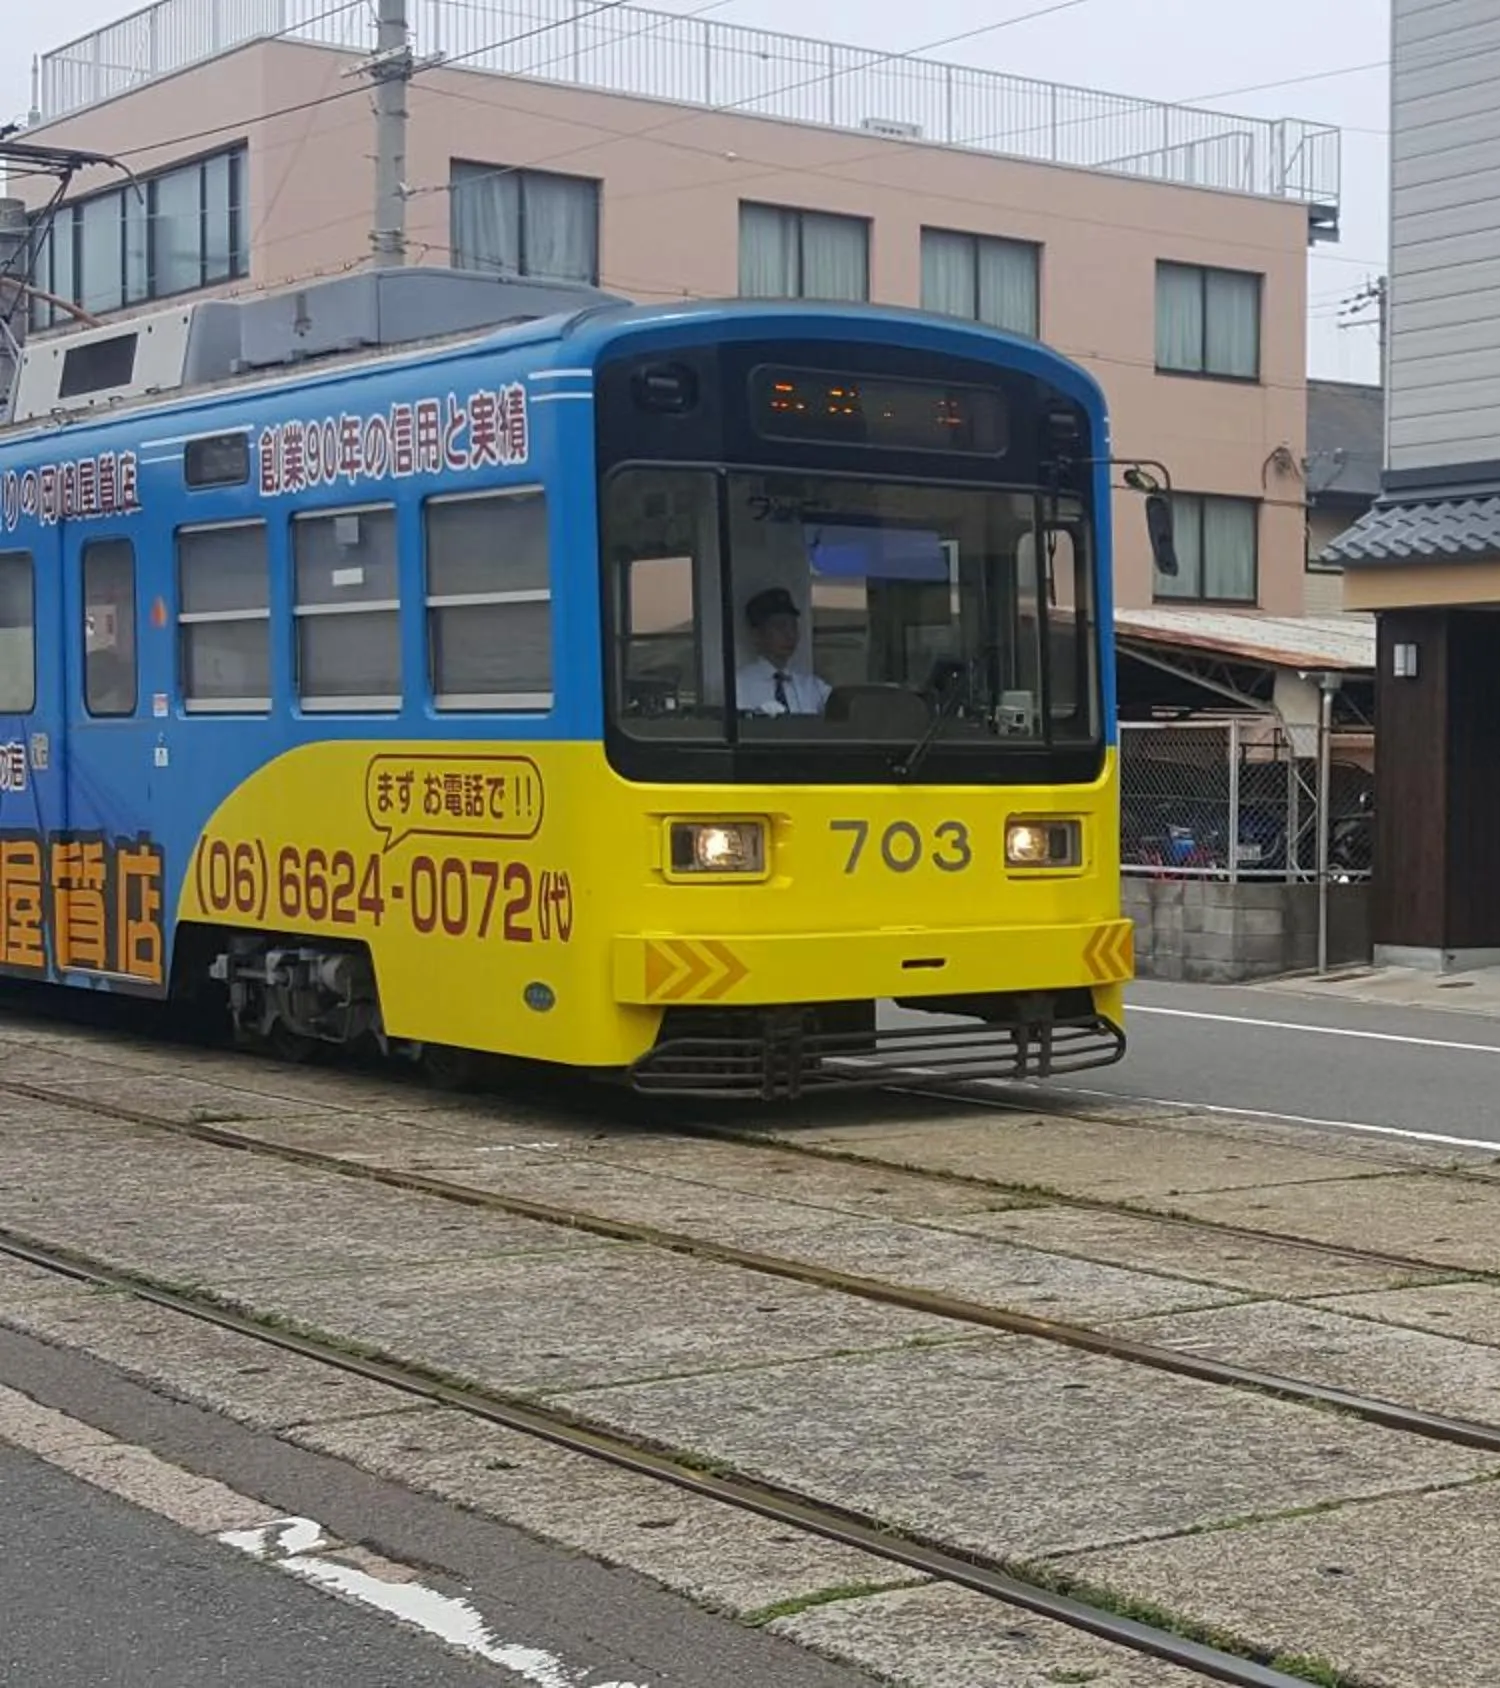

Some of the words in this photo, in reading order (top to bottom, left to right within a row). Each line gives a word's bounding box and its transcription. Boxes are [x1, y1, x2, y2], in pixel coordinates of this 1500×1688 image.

[259, 382, 528, 496] 創業90年の信用と実績
[829, 819, 972, 874] 703
